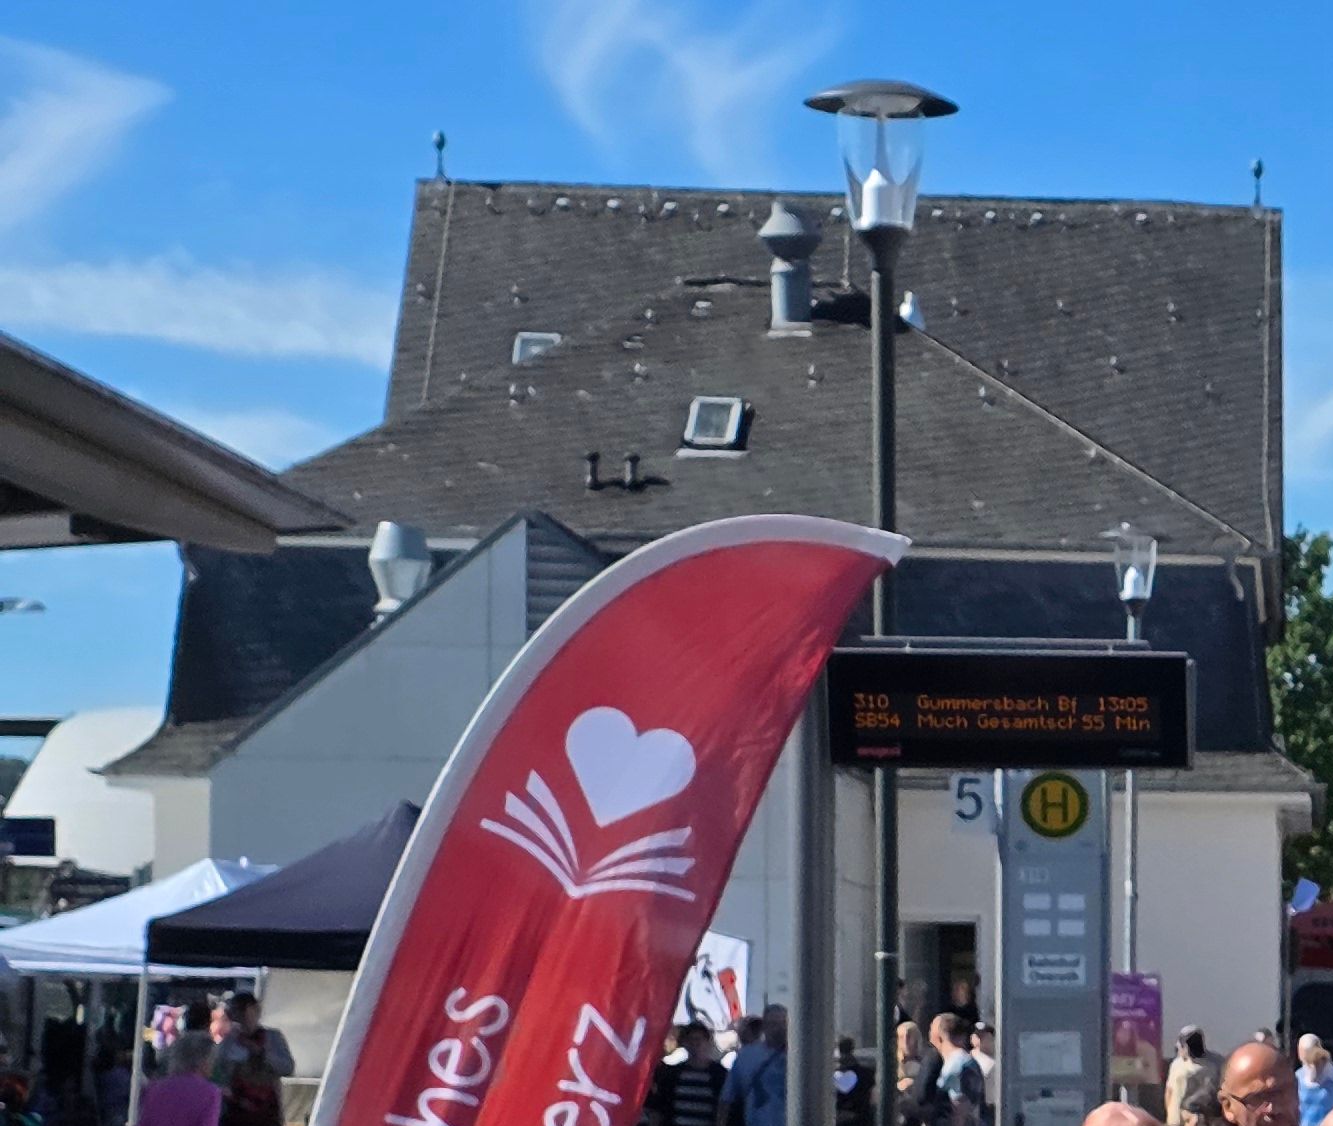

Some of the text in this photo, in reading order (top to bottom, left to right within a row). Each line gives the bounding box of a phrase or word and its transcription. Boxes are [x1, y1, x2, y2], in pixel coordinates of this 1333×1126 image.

[854, 694, 889, 709] 310
[917, 694, 1049, 711] Gummersbach
[1099, 697, 1149, 712] 13:05
[854, 711, 900, 729] SB54
[917, 713, 968, 729] Much
[1081, 714, 1105, 731] 55
[1115, 715, 1150, 732] Min
[955, 777, 983, 821] 5
[1040, 786, 1070, 824] H
